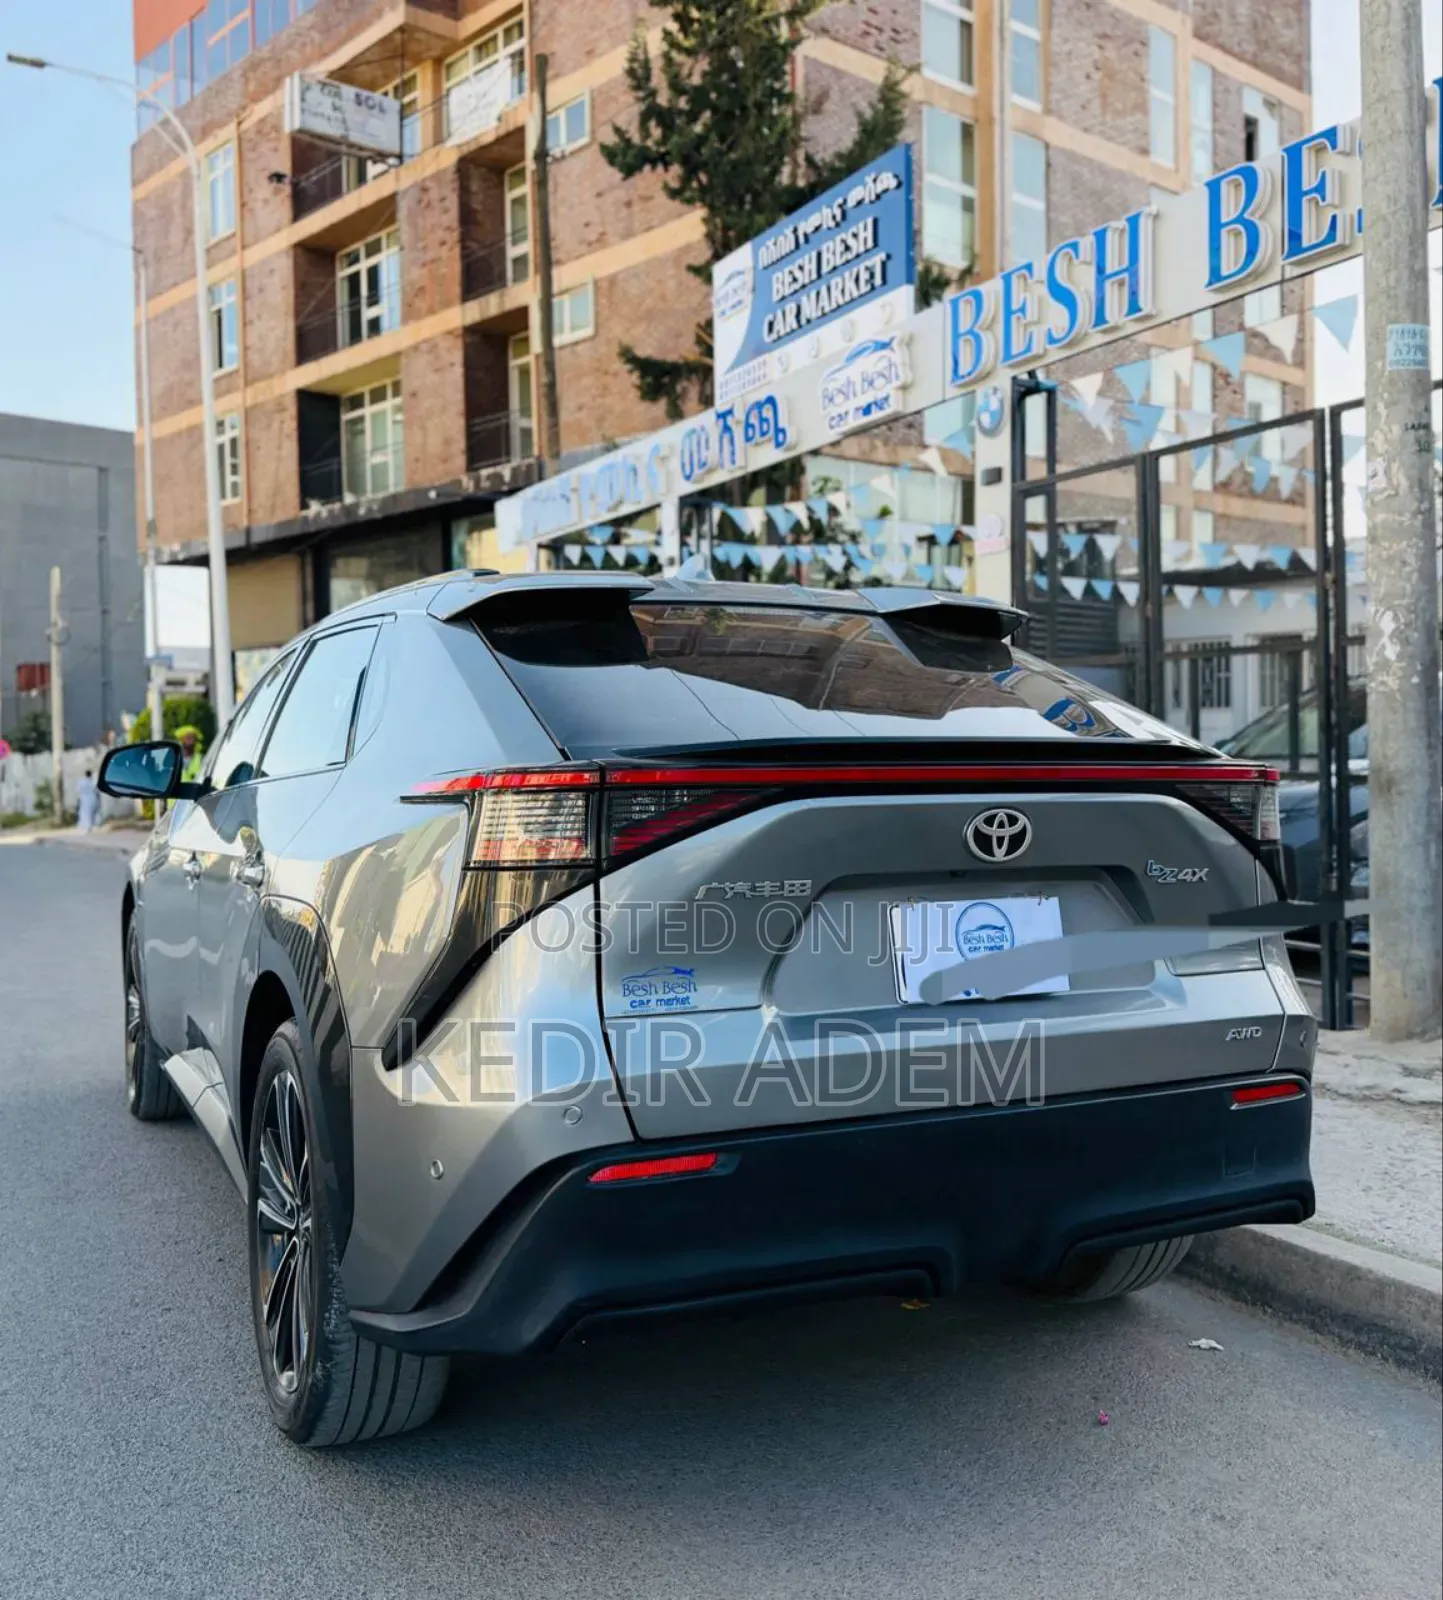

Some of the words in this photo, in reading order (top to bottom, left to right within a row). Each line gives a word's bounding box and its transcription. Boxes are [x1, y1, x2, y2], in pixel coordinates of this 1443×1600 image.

[771, 249, 821, 303] BESH
[821, 216, 878, 276] BESH
[763, 302, 800, 343] CAR
[800, 251, 889, 325] MARKET
[947, 210, 1156, 387] BESH
[821, 373, 857, 411] Besh
[860, 355, 900, 395] Besh
[828, 411, 850, 430] car
[694, 879, 812, 900] 广汽丰田
[963, 933, 985, 945] Besh
[987, 931, 1009, 944] Besh
[622, 981, 658, 997] Besh
[662, 978, 698, 995] Besh
[629, 999, 652, 1009] car
[655, 995, 691, 1008] market
[1225, 1026, 1263, 1041] AWD
